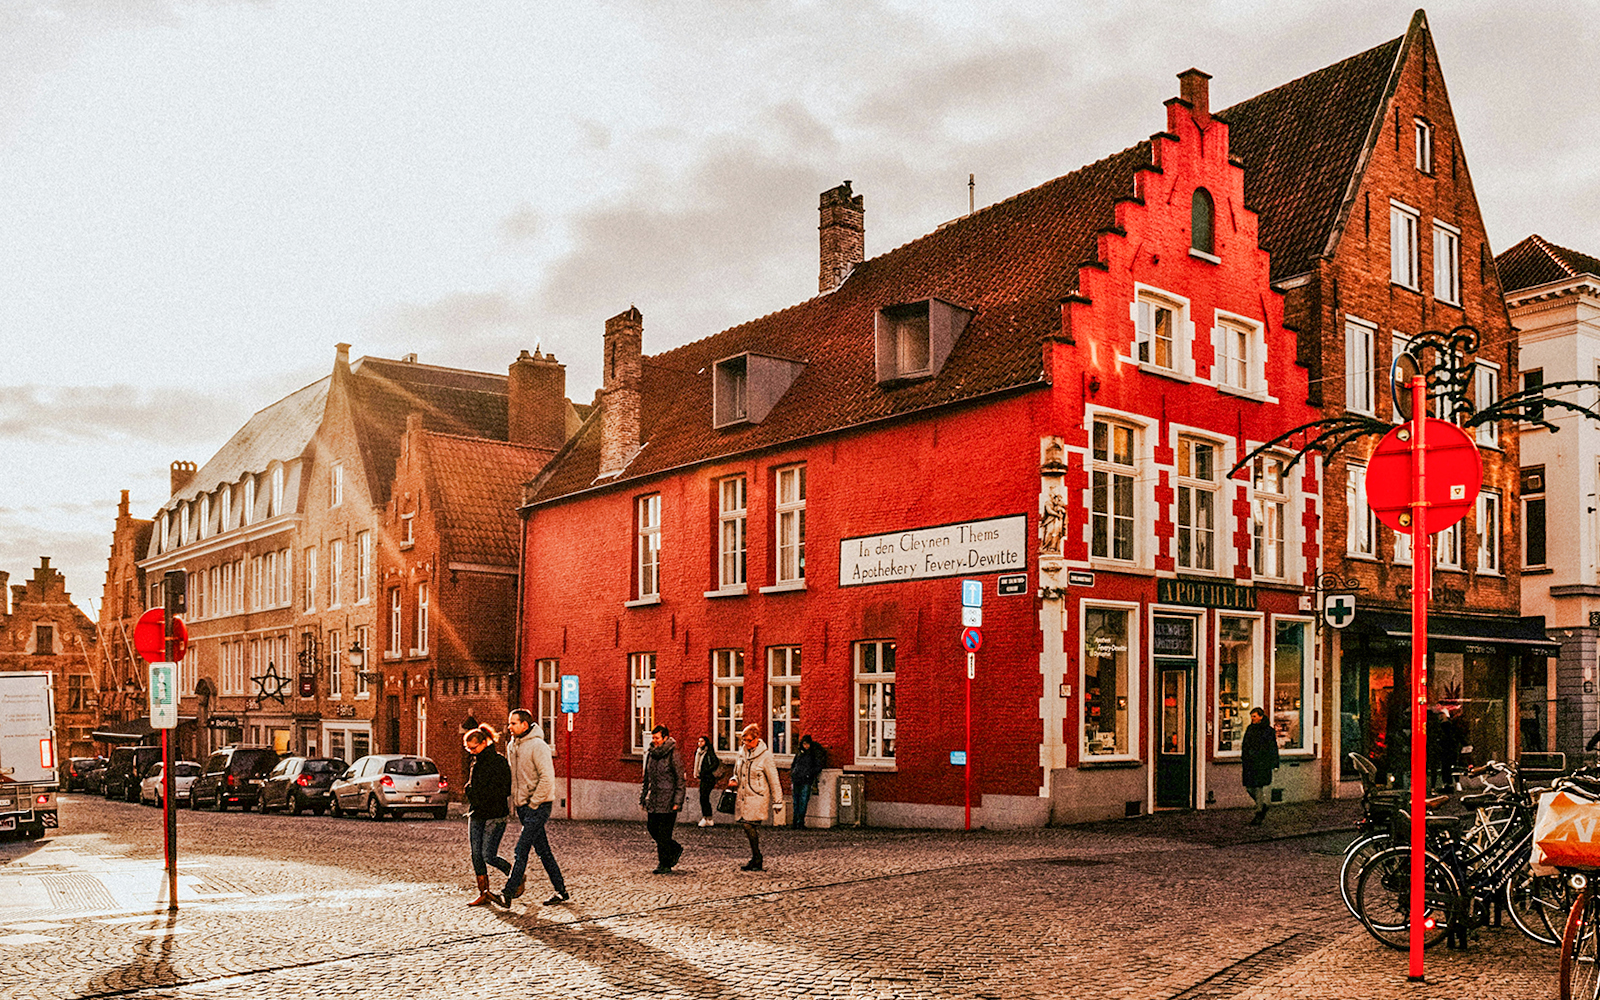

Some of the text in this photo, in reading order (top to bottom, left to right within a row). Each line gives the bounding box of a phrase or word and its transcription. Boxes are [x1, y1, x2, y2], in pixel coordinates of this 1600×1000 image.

[858, 525, 1000, 557] In den Cleynen Thems
[852, 549, 1018, 583] Apothekery Fevery-Dewitte
[1162, 582, 1255, 608] APOTHEEK
[563, 679, 577, 700] P
